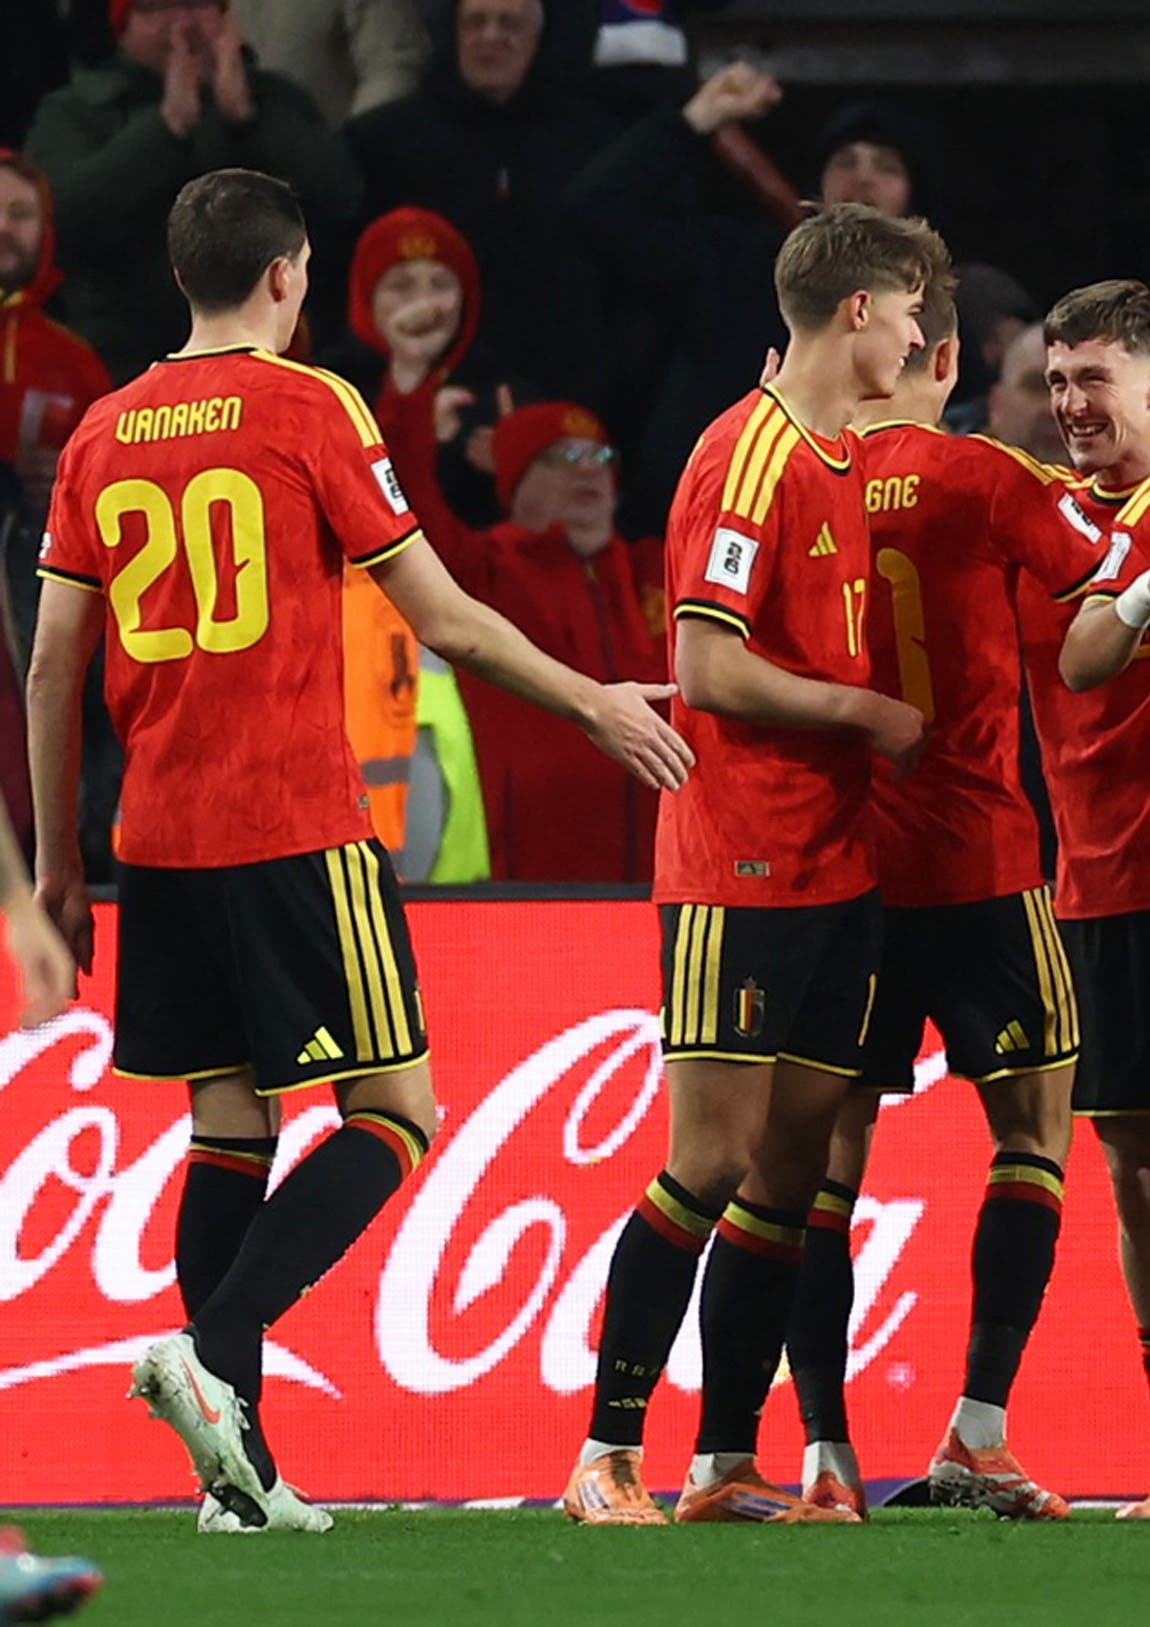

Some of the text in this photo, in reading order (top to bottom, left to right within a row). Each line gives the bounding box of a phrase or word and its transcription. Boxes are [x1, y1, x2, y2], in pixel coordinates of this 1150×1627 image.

[115, 395, 242, 444] VANAKEN
[95, 467, 271, 664] 20
[842, 577, 866, 658] 17
